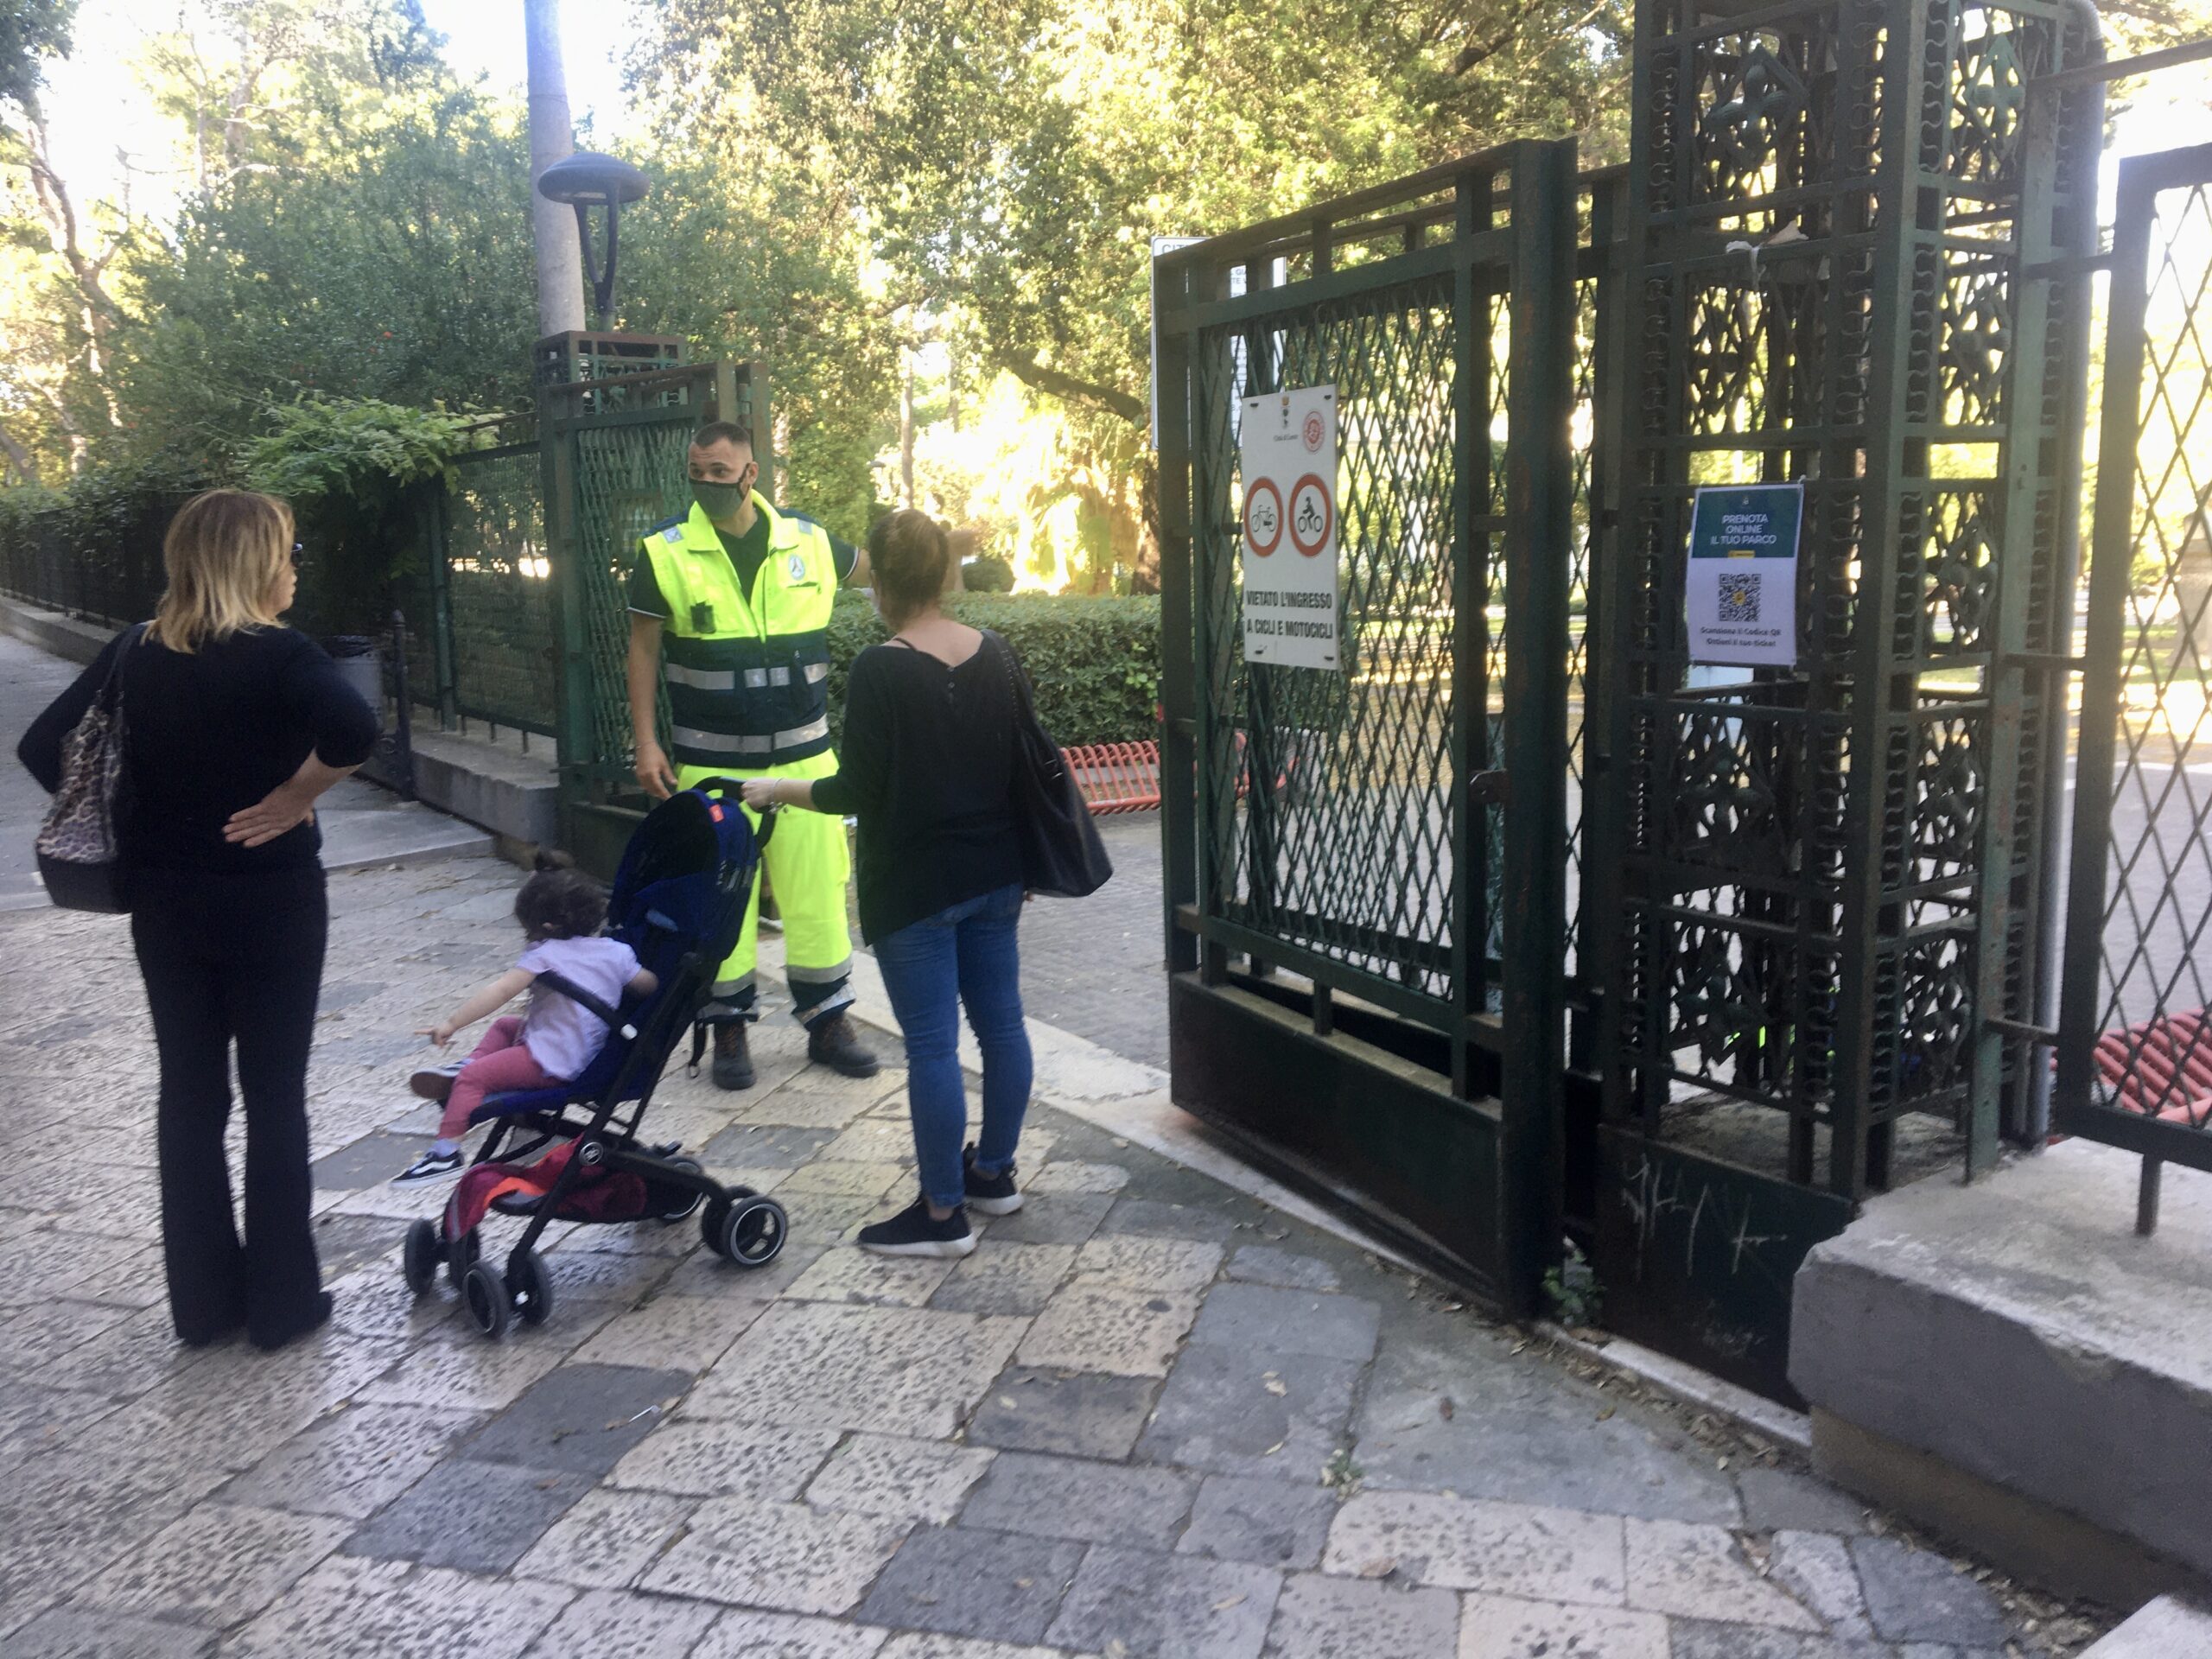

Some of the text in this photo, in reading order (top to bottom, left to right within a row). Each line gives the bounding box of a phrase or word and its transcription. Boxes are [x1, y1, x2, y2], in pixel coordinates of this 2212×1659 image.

[1721, 514, 1769, 524] PRENOTA
[1725, 524, 1764, 534] ONLINE
[1711, 535, 1777, 545] IL TUO PARCO
[1246, 591, 1332, 608] VIETATO L'INGRESSO
[1246, 619, 1333, 639] A CICLI E MOTOCICLI
